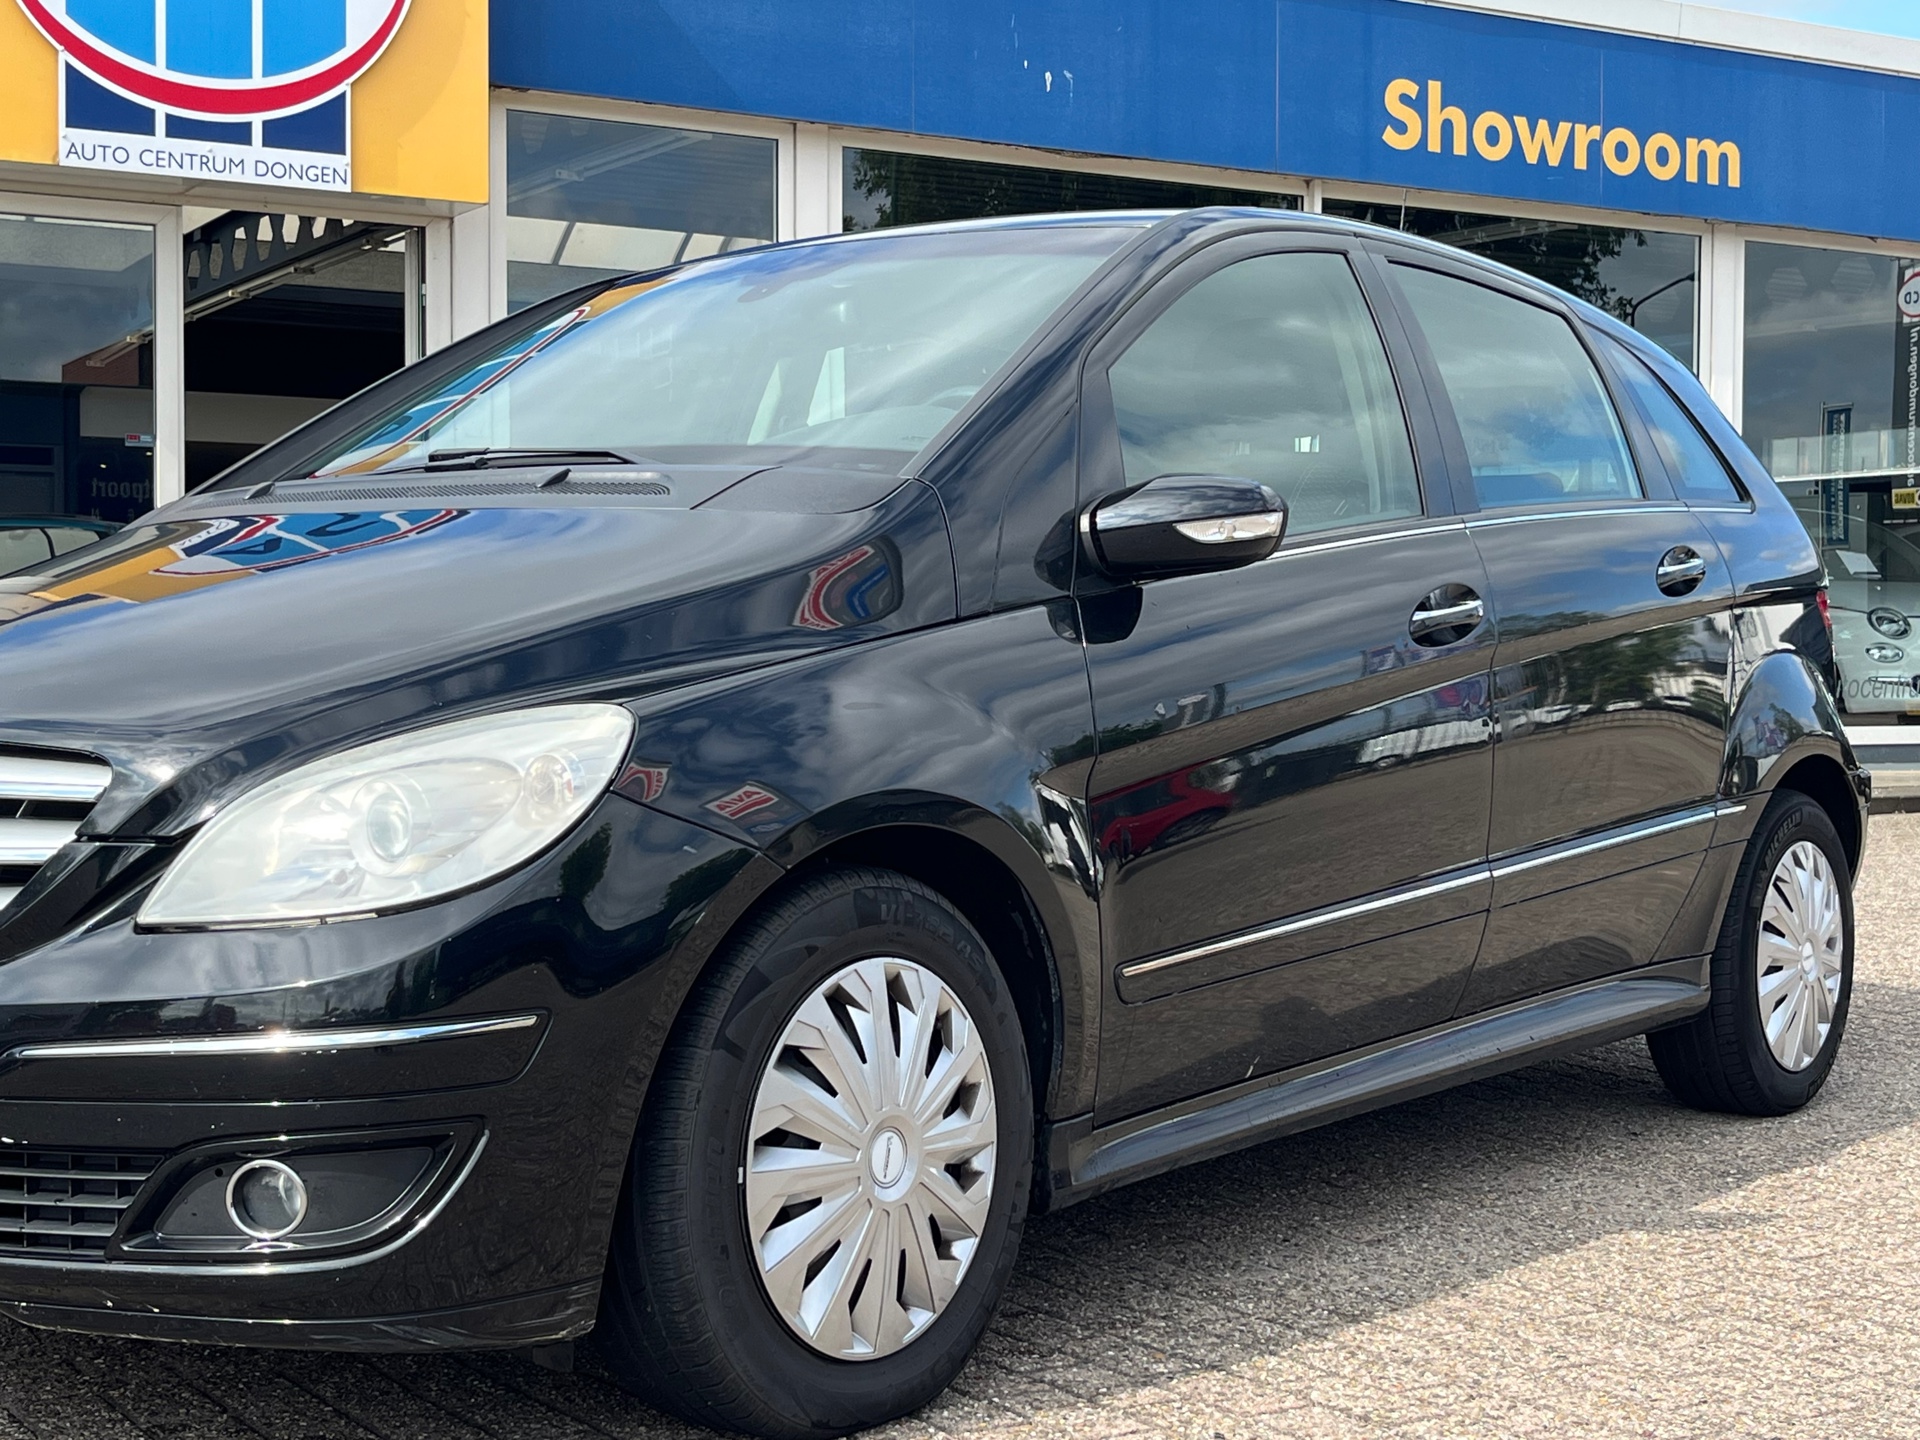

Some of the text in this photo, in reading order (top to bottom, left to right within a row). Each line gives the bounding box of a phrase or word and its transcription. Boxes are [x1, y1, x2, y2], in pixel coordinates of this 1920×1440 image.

[1381, 78, 1741, 188] Showroom
[65, 142, 348, 185] AUTO CENTRUM DONGEN
[1764, 809, 1802, 869] MICHELIN
